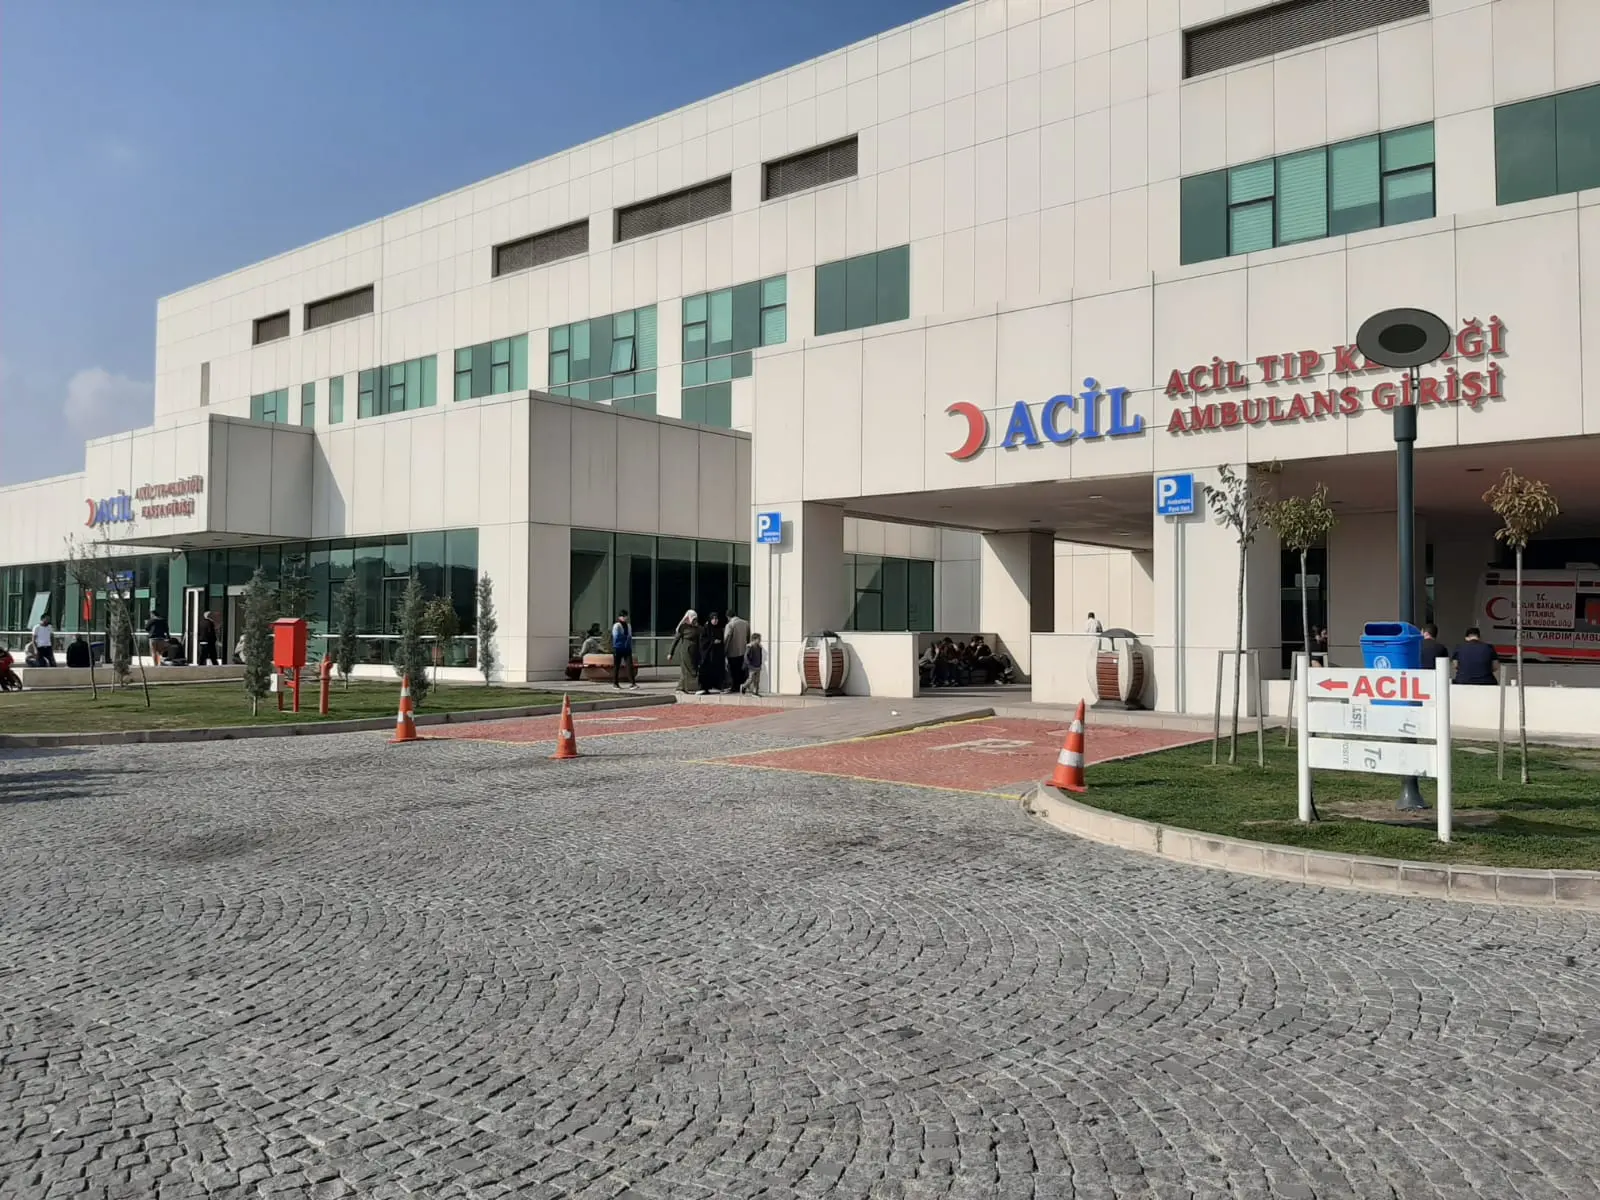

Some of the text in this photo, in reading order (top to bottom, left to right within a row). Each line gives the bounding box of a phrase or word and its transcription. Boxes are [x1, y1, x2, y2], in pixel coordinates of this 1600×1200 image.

[1164, 350, 1321, 395] ACİL TIP
[1167, 361, 1503, 432] AMBULANS GİRİŞİ
[1000, 377, 1143, 447] ACİL
[1159, 479, 1177, 507] P
[758, 515, 771, 538] P
[1537, 632, 1572, 641] YARDIM
[1352, 671, 1431, 700] ACİL
